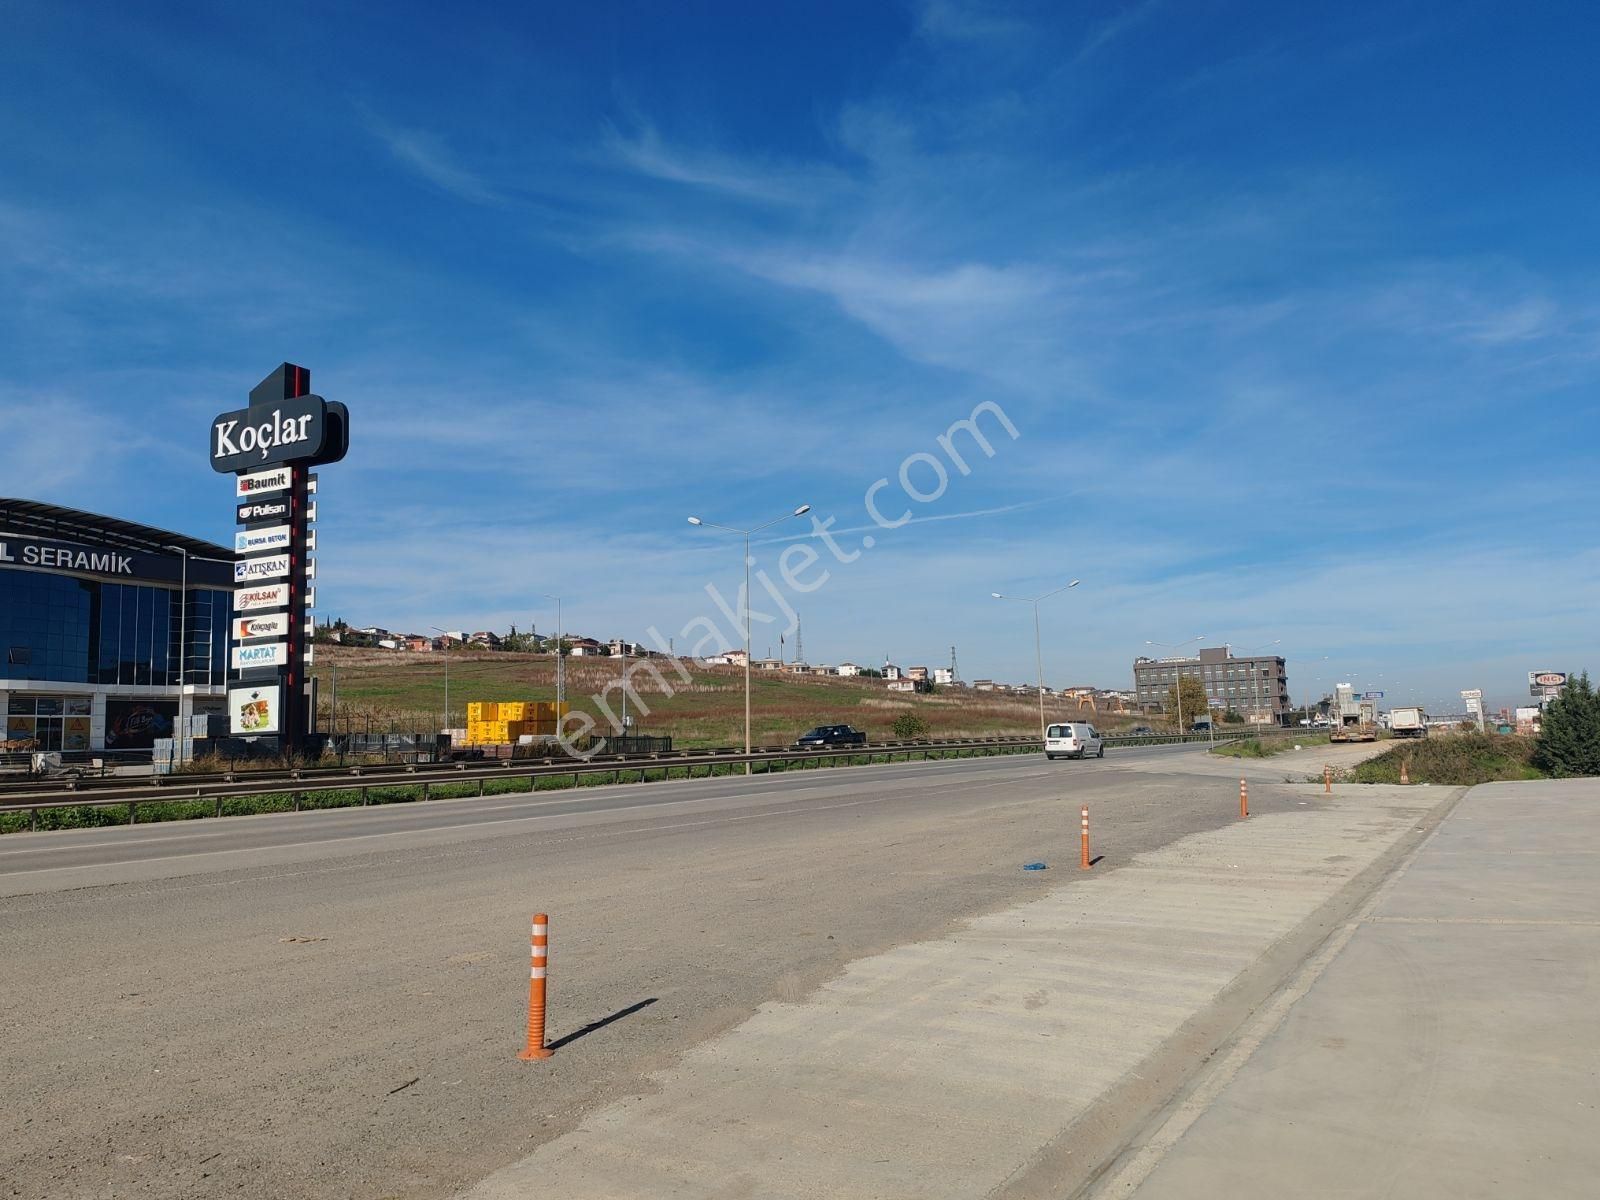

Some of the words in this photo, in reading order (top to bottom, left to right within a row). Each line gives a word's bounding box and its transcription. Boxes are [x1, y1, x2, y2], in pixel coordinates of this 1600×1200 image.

[214, 410, 312, 459] Koçlar
[247, 473, 286, 491] Baumit
[254, 504, 285, 516] Polisan
[248, 535, 266, 547] BURSA
[22, 545, 133, 574] SERAMİK
[239, 646, 276, 660] MARTAT
